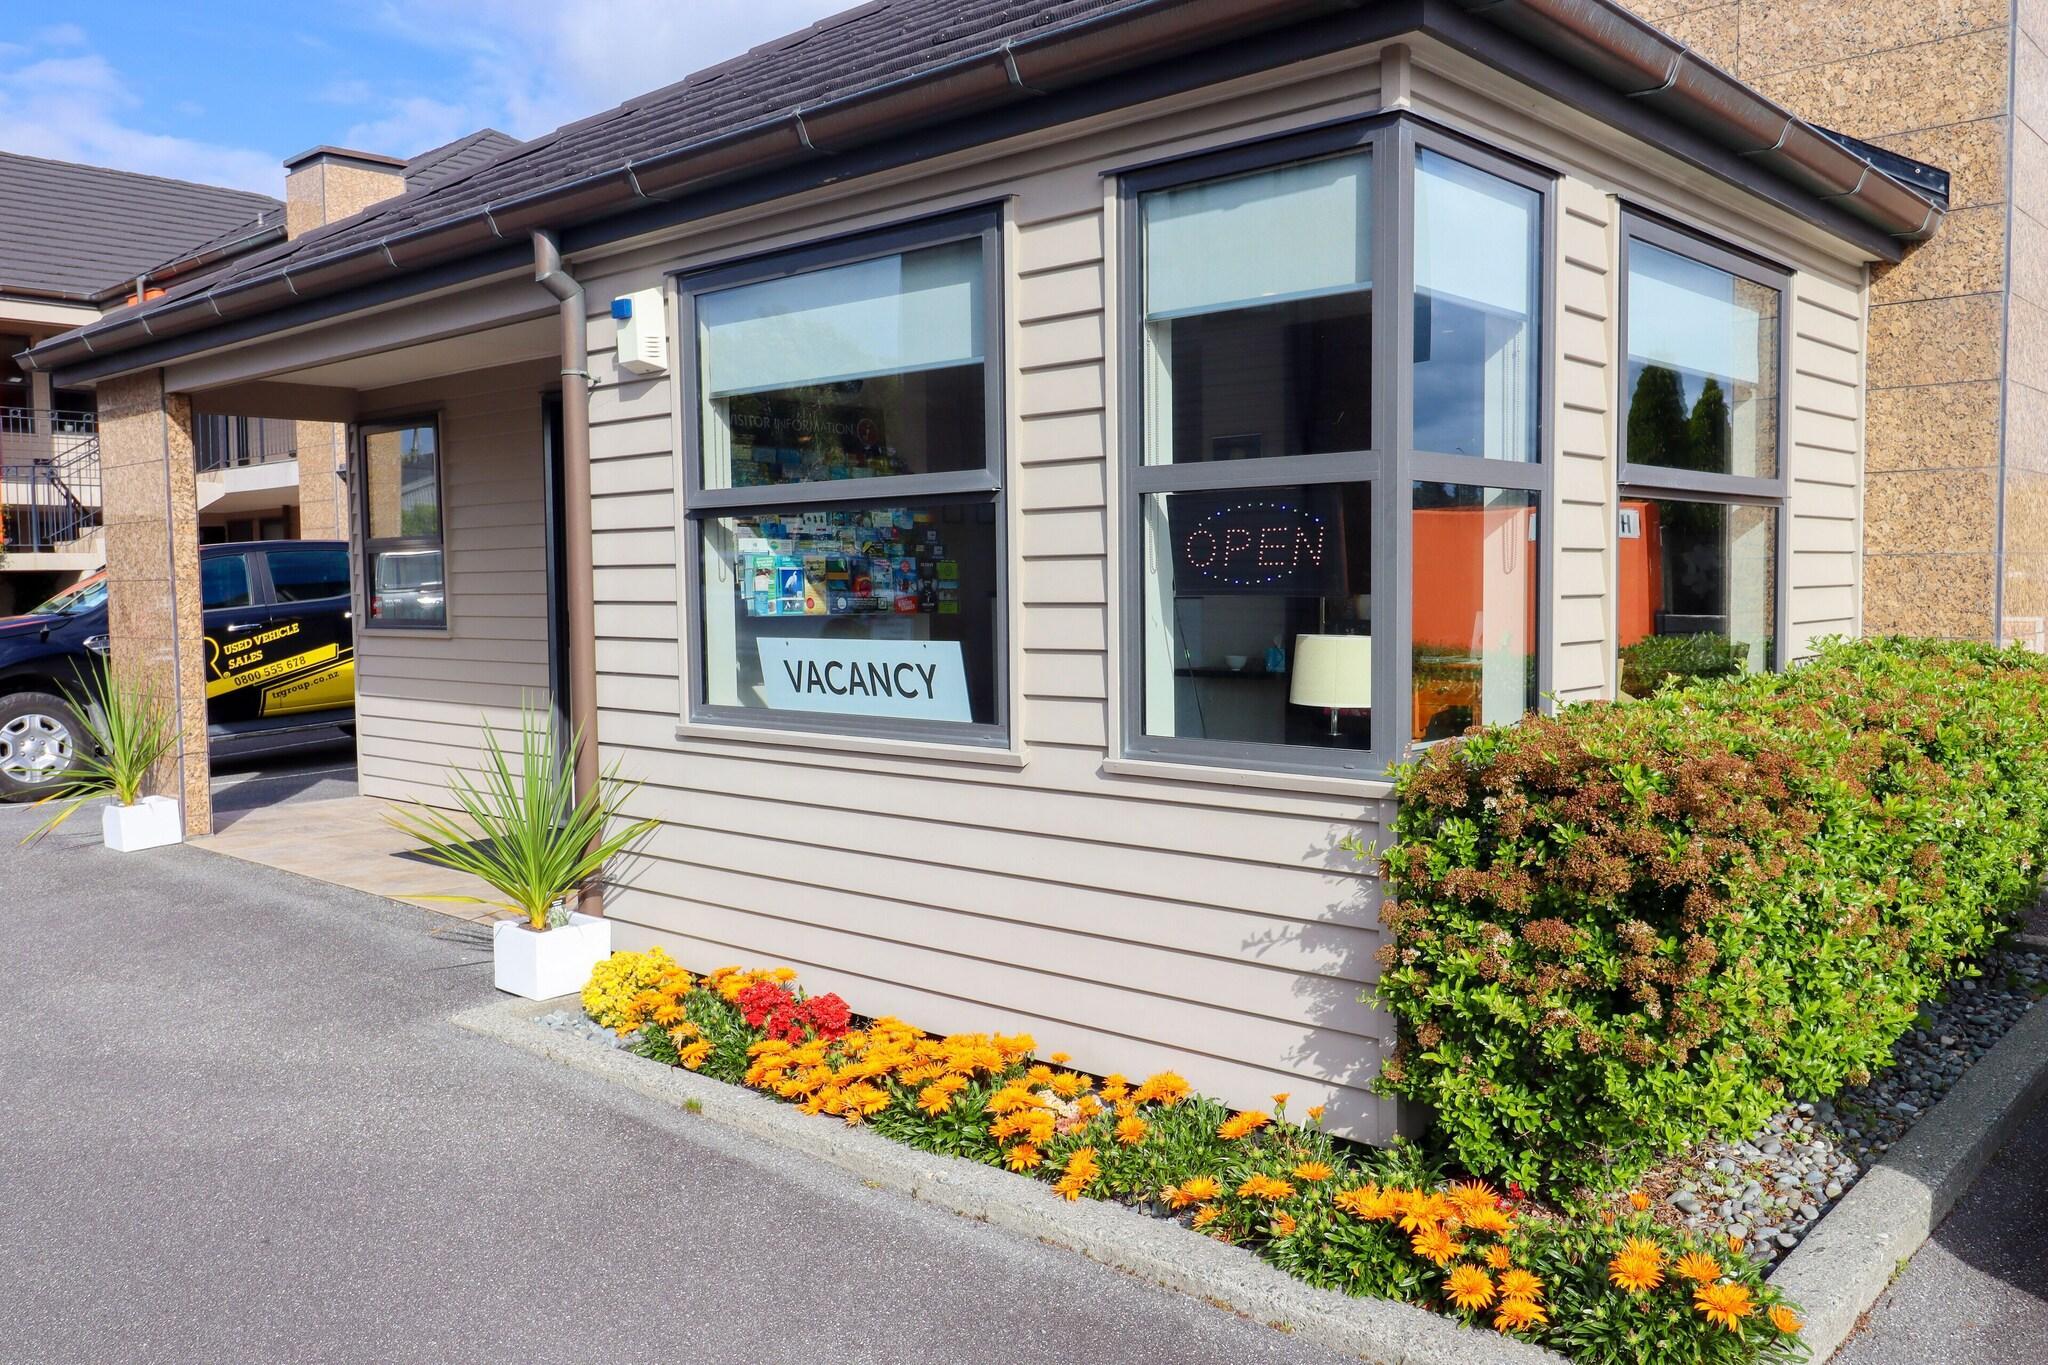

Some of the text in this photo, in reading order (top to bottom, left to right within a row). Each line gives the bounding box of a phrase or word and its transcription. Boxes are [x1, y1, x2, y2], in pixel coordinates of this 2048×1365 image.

[774, 417, 854, 435] INFORMATION
[1185, 526, 1325, 568] OPEN
[224, 623, 300, 655] USED VEHICLE
[228, 650, 263, 670] SALES
[234, 656, 306, 686] 0800 555 678
[271, 671, 339, 699] trgroup.co.nz
[783, 660, 937, 699] VACANCY
